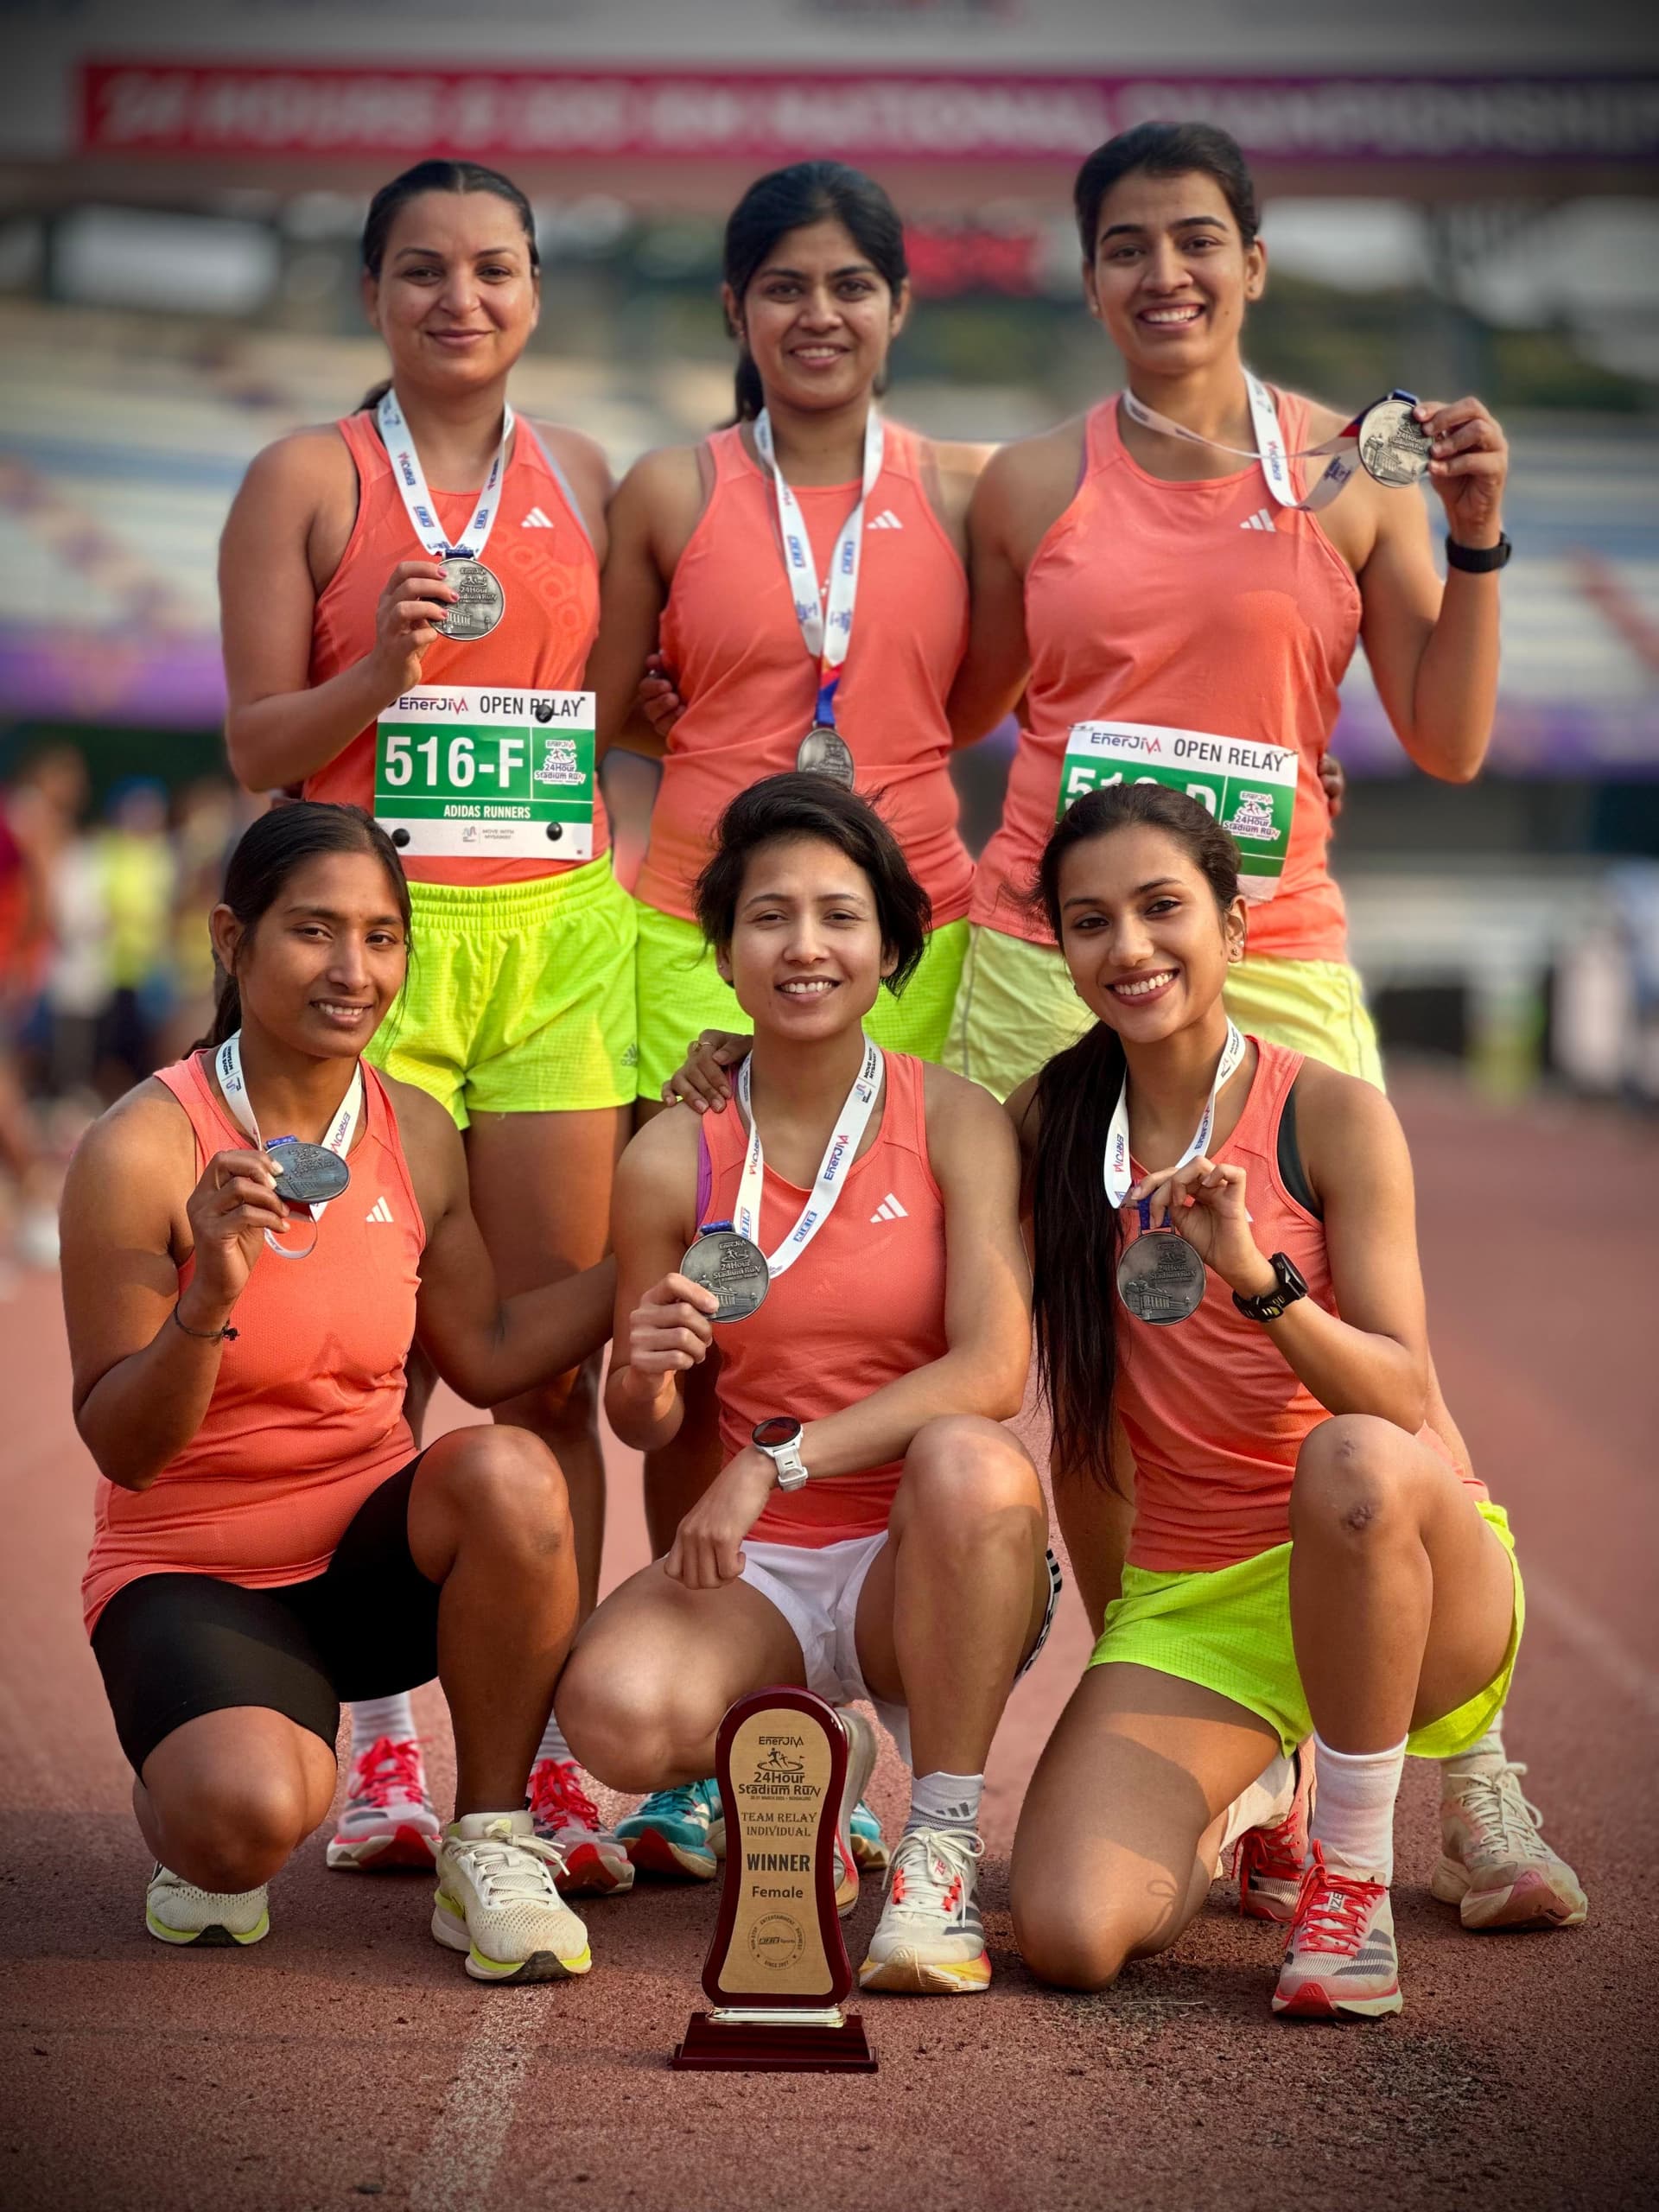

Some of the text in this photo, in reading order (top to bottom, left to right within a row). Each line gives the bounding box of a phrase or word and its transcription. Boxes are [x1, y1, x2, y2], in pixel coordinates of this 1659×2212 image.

[480, 696, 524, 715] OPEN
[385, 735, 524, 788] 516-F
[1173, 738, 1284, 772] OPEN RELAY
[443, 804, 531, 819] ADIDAS RUNNERS
[1223, 821, 1259, 833] Stadium
[1236, 815, 1269, 827] 24Hour
[753, 1771, 805, 1784] 24Hour
[738, 1783, 791, 1796] Stadium
[741, 1811, 818, 1823] TEAM RELAY
[747, 1825, 811, 1837] INDIVIDUAL
[747, 1853, 810, 1872] WINNER
[752, 1885, 804, 1898] Female
